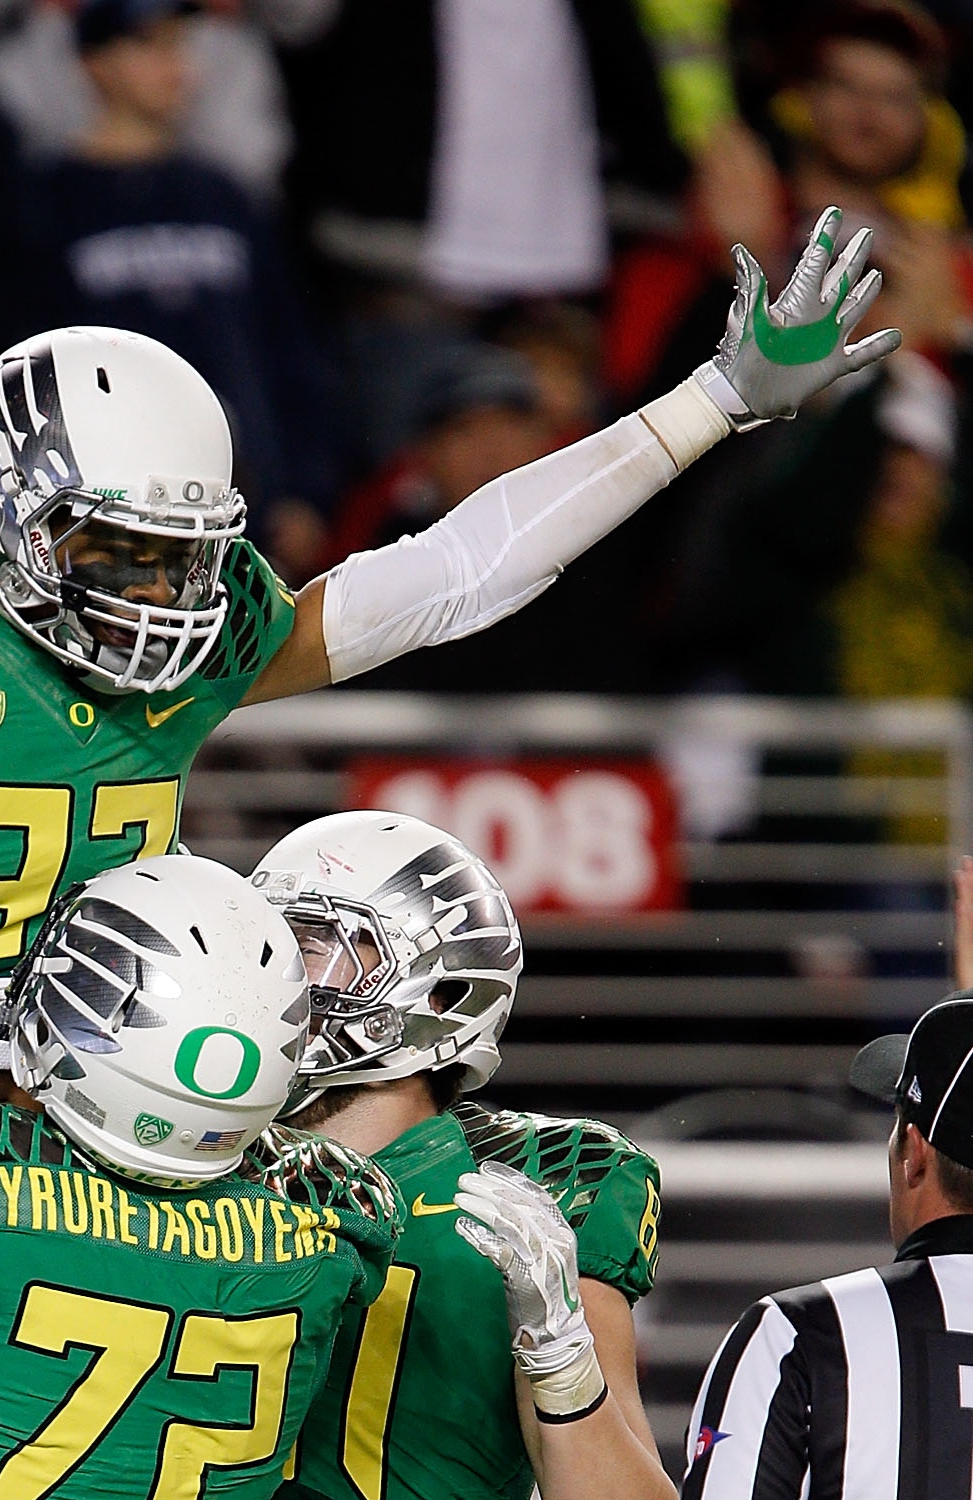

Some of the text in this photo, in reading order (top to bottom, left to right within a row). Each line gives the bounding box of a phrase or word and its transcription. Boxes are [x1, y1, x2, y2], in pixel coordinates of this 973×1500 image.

[182, 480, 205, 502] O
[69, 702, 95, 727] O
[377, 768, 659, 908] 108
[251, 871, 270, 888] O
[173, 1025, 262, 1100] O
[139, 1128, 158, 1142] 12
